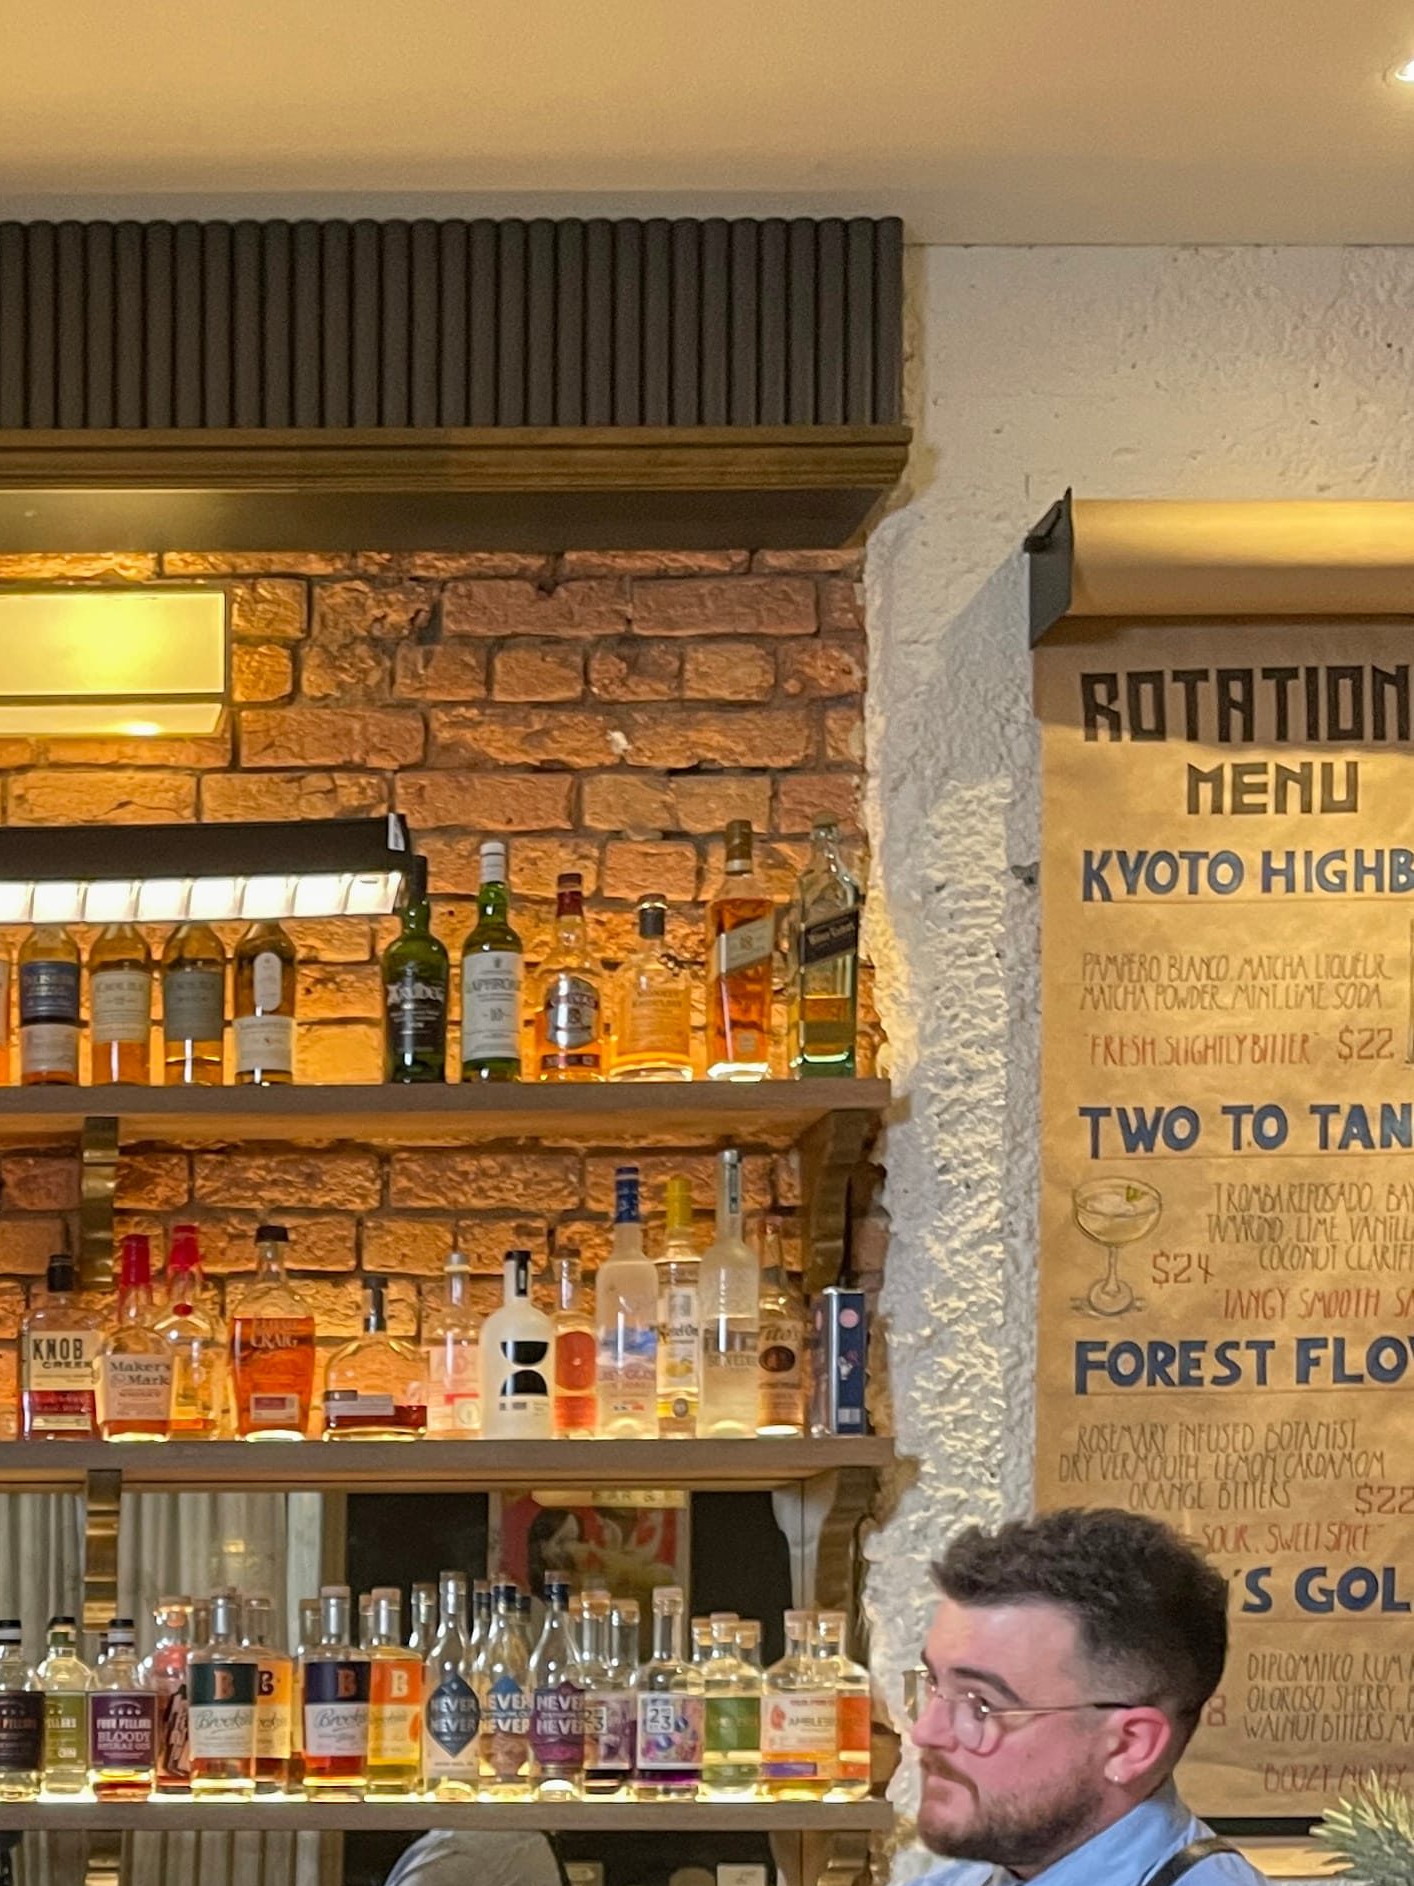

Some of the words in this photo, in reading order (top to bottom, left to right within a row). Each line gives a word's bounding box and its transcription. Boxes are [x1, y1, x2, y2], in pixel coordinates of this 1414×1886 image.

[1081, 665, 1410, 742] ROTATION
[1187, 761, 1359, 815] MENU
[1082, 850, 1245, 902] KYOTO
[1261, 849, 1414, 894] HIGHB
[1237, 955, 1309, 981] MATCHA
[1080, 982, 1149, 1011] MATCHA
[1338, 1023, 1395, 1063] $22
[1079, 1106, 1200, 1159] TWO
[1221, 1104, 1288, 1151] TO
[1309, 1103, 1413, 1151] TAN
[1152, 1250, 1215, 1289] $24
[32, 1338, 84, 1361] KNOB
[1075, 1339, 1276, 1396] FOREST
[1295, 1335, 1414, 1386] FLO
[110, 1361, 171, 1373] Maker's
[128, 1374, 170, 1386] Mark
[1077, 1421, 1169, 1453] ROSEMARY
[1178, 1420, 1255, 1454] INFUSED
[1354, 1483, 1414, 1517] $22
[1294, 1566, 1412, 1615] GOL
[214, 1668, 235, 1701] B
[337, 1668, 356, 1698] B
[391, 1670, 410, 1698] B
[430, 1695, 478, 1712] NEVER
[97, 1731, 152, 1743] BLOODY
[430, 1718, 478, 1733] NEVER
